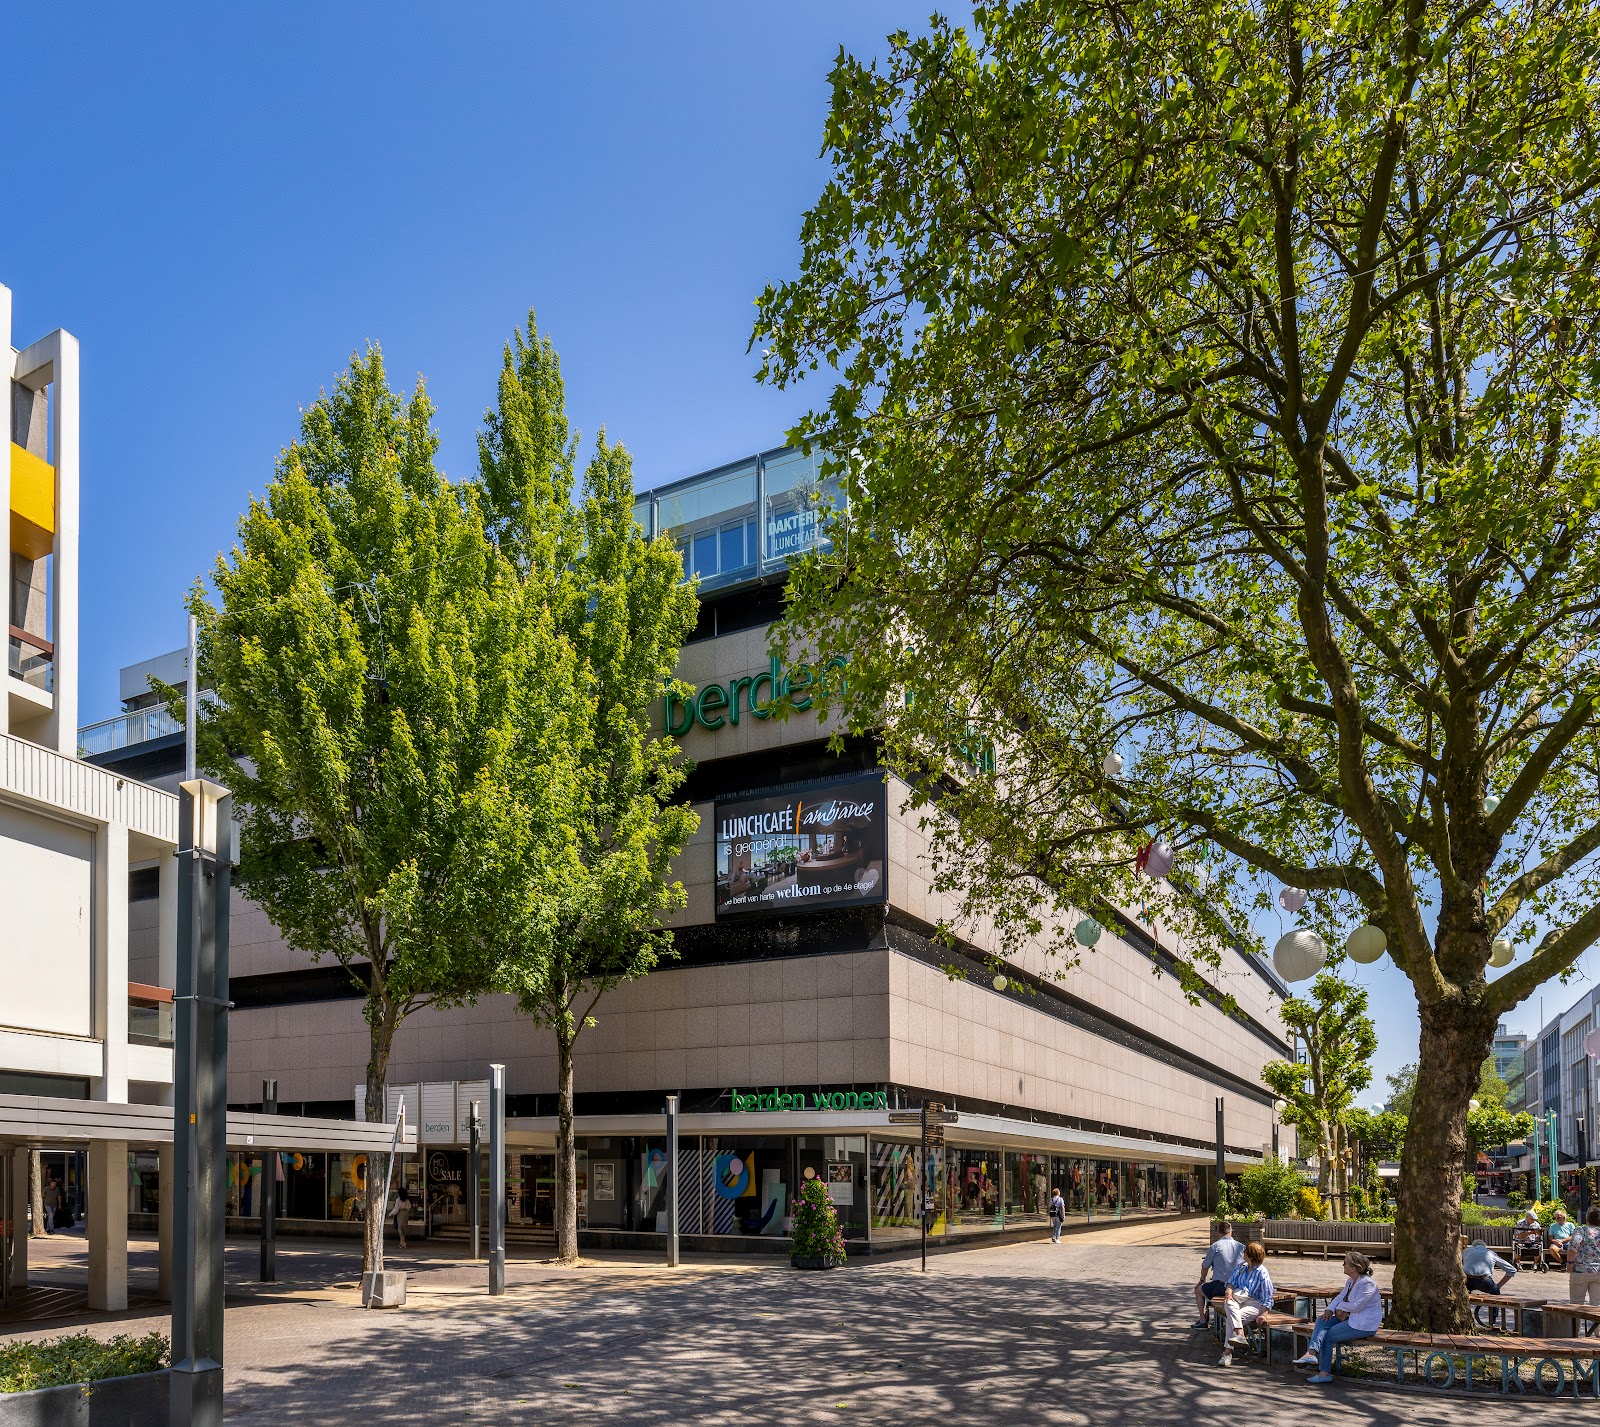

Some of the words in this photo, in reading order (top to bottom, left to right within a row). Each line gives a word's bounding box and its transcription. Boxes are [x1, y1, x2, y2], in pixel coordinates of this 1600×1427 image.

[722, 804, 793, 840] LUNCHCAFÉ
[802, 799, 874, 826] ambiance
[723, 842, 733, 856] is
[735, 834, 787, 857] geopend!
[760, 892, 775, 901] harte
[776, 884, 822, 899] welkom
[823, 886, 832, 895] op
[833, 883, 842, 893] de
[843, 882, 852, 891] 4e
[732, 1088, 805, 1112] berden
[812, 1091, 887, 1111] wonen
[425, 1122, 450, 1132] berden
[441, 1170, 462, 1181] SALE
